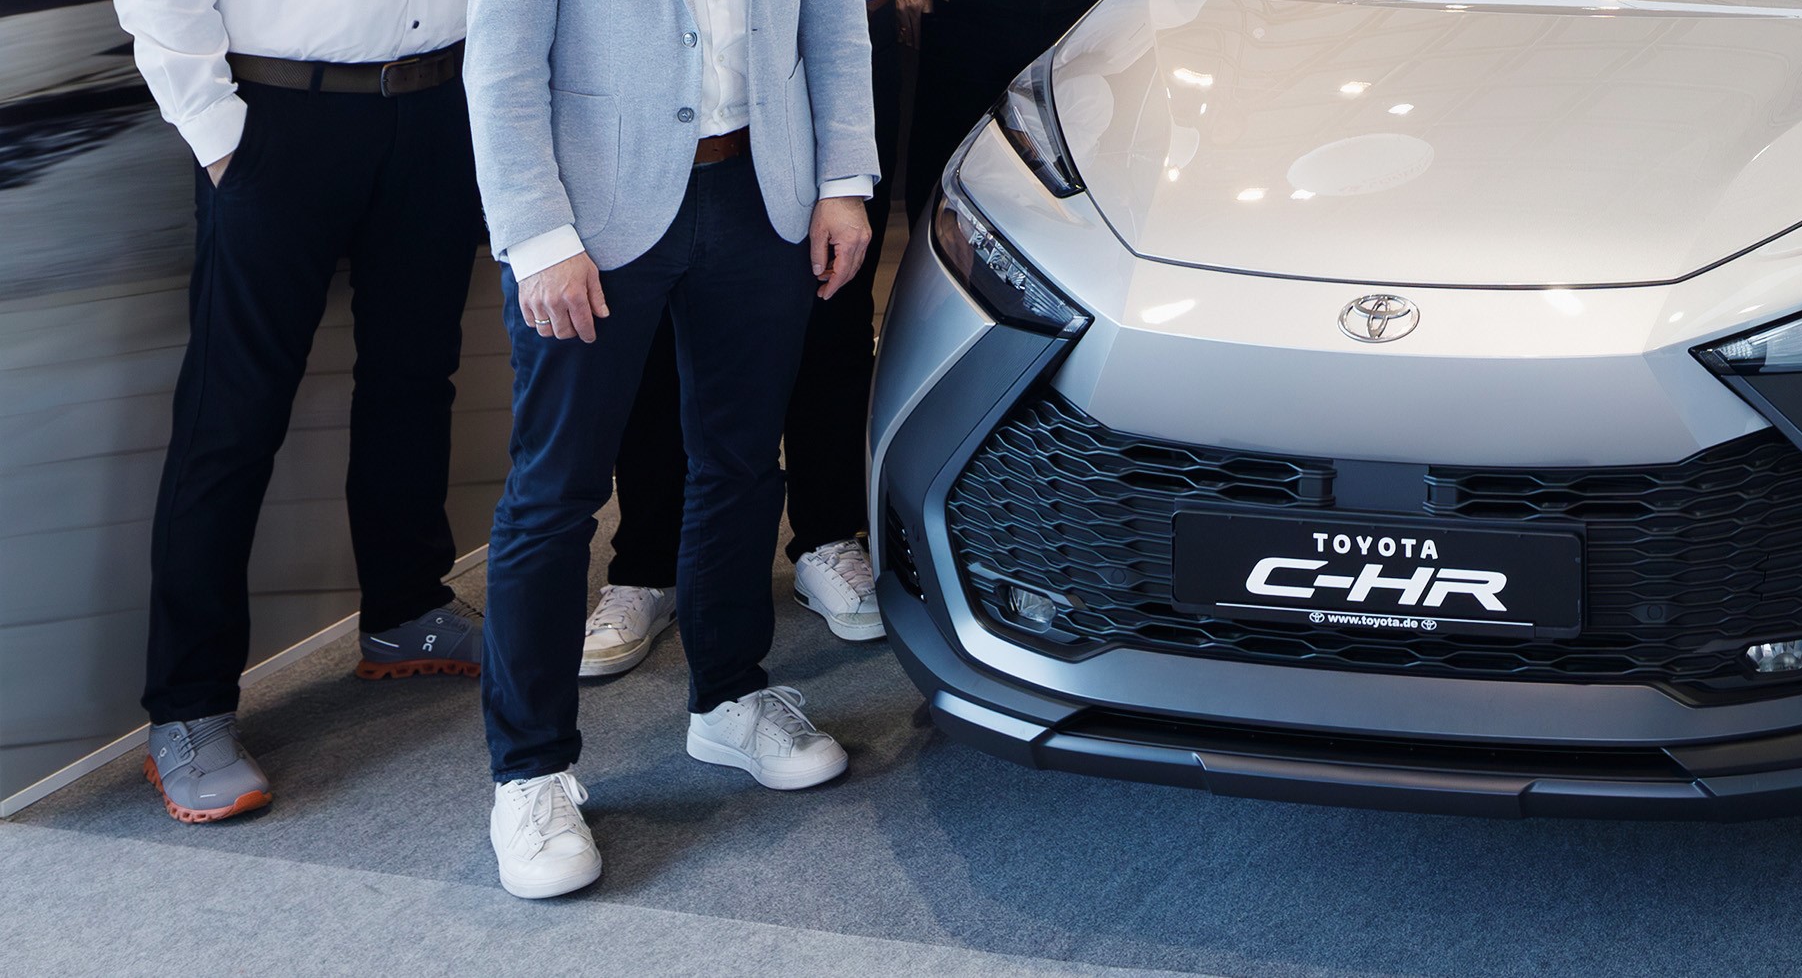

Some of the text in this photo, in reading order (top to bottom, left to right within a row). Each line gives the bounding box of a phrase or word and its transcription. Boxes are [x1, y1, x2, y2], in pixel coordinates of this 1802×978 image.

[1313, 532, 1440, 560] TOYOTA
[1245, 557, 1508, 612] C-HR
[1328, 613, 1419, 630] www.toyota.de
